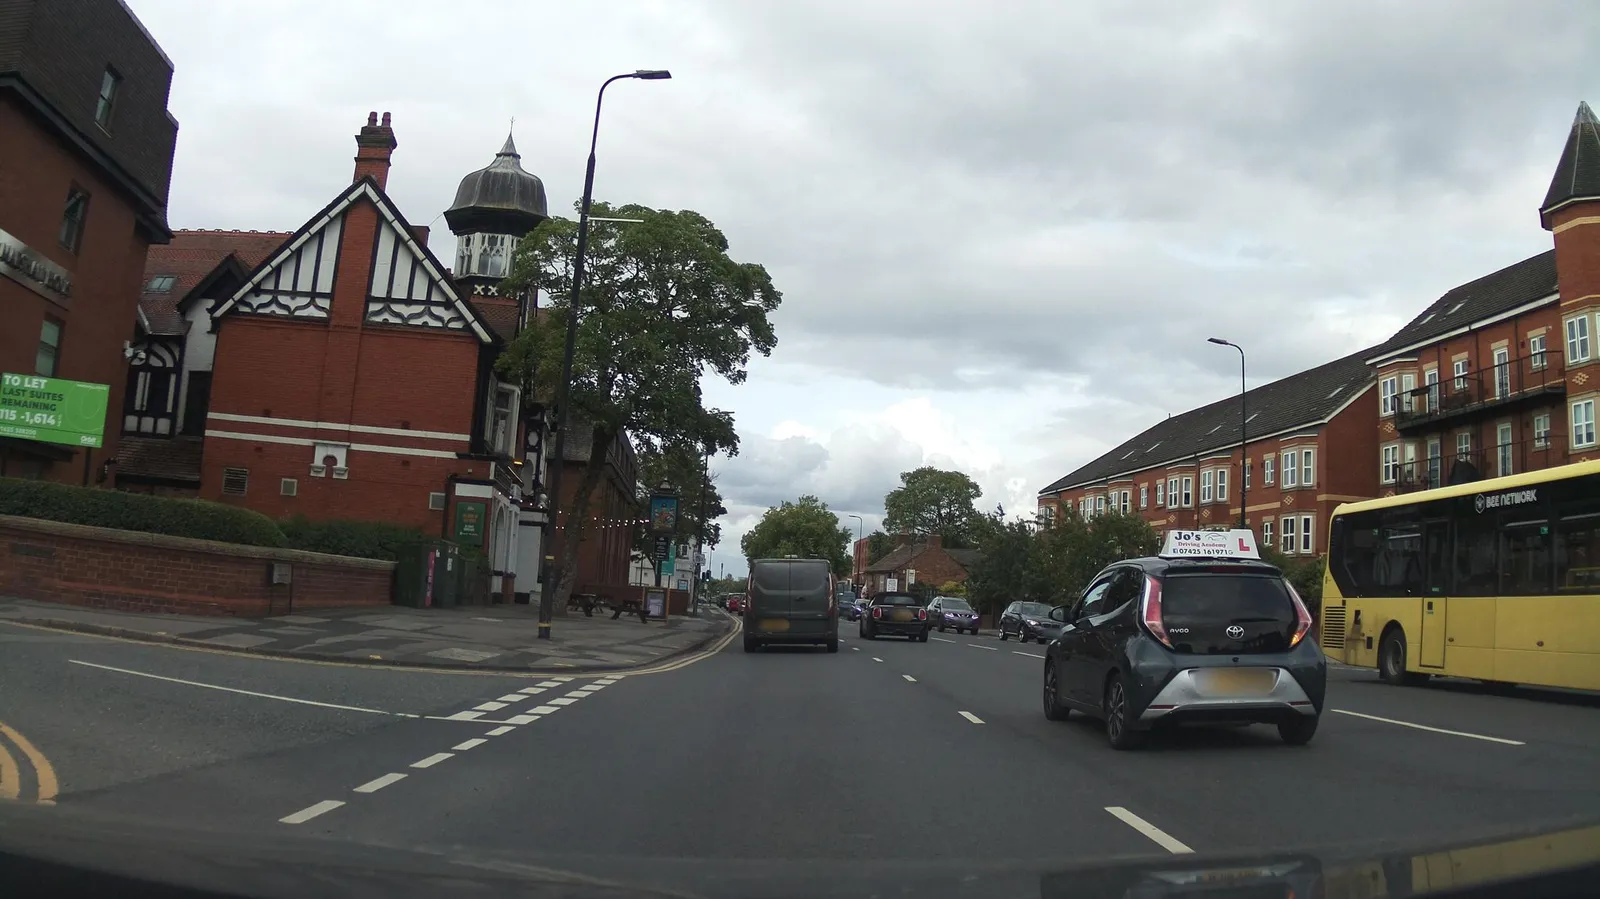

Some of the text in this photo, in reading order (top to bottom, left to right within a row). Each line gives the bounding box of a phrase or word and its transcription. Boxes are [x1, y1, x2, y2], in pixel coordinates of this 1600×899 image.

[4, 375, 48, 389] TO LET
[3, 388, 64, 402] LAST SUITES
[1, 398, 57, 412] REMAINING
[1486, 489, 1537, 508] BEE NETWORK
[1174, 531, 1201, 541] Jo's
[1238, 538, 1251, 552] L
